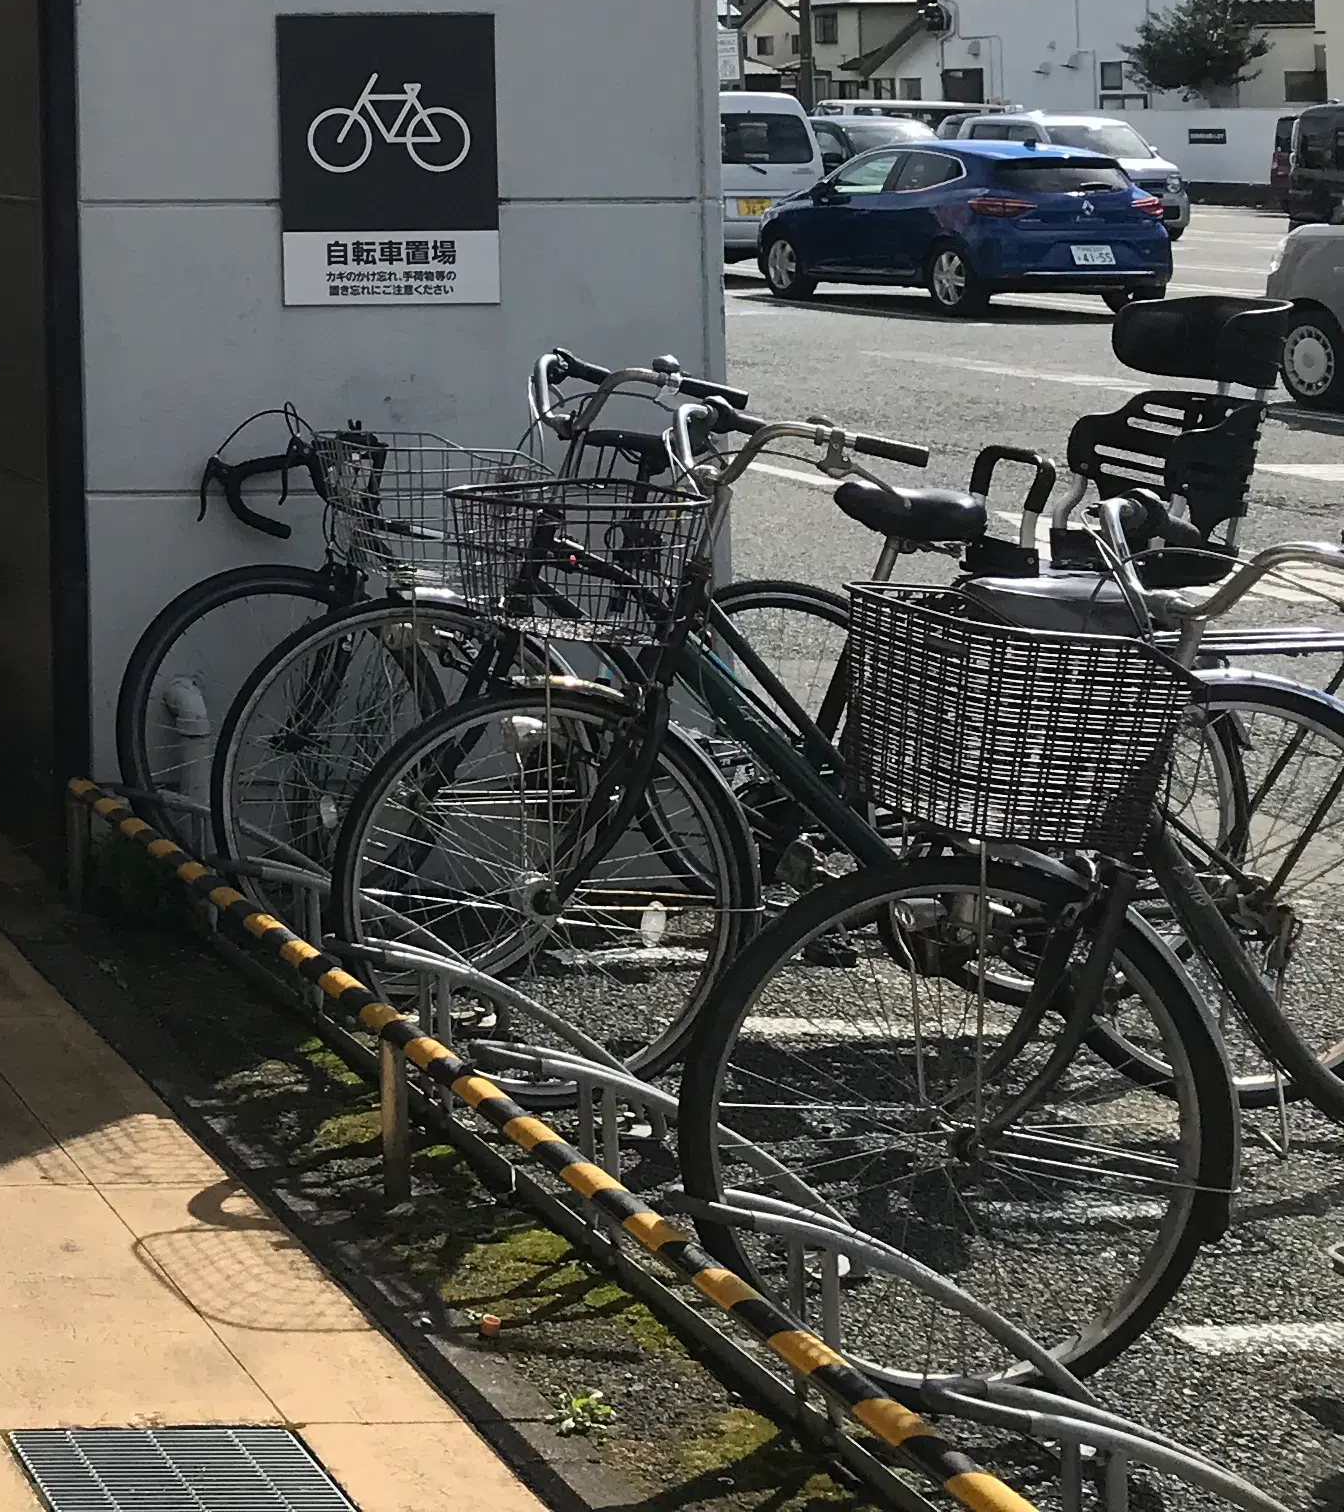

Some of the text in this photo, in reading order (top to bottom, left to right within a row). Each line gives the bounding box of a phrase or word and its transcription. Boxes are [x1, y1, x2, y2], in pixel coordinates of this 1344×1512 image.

[326, 240, 457, 266] 自転車置場
